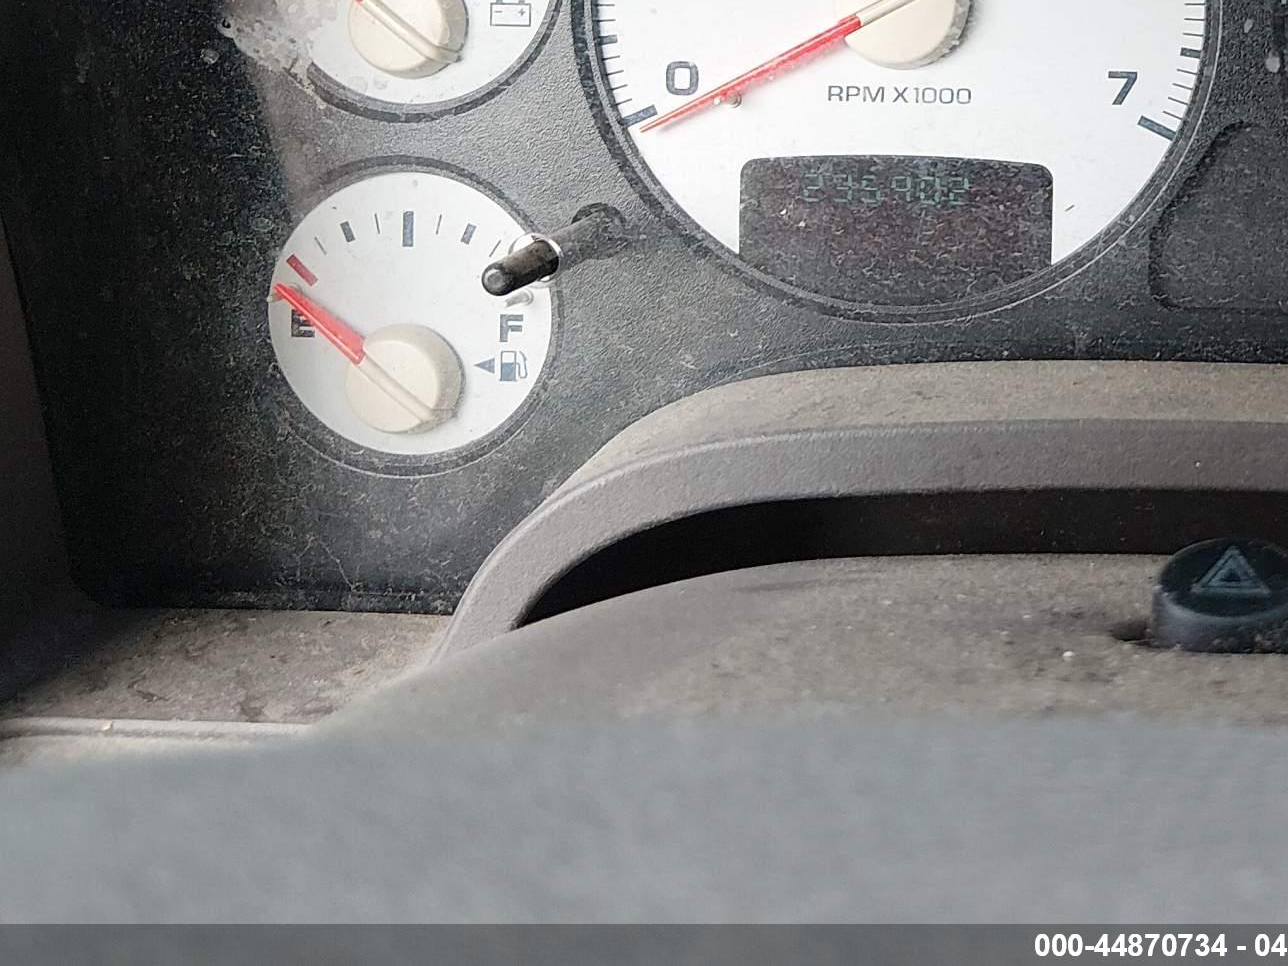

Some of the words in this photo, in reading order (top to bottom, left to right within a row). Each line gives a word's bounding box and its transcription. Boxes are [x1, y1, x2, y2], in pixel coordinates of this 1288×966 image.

[666, 61, 698, 96] 0
[828, 85, 886, 103] RPM
[1107, 70, 1139, 105] 7
[500, 314, 524, 342] F
